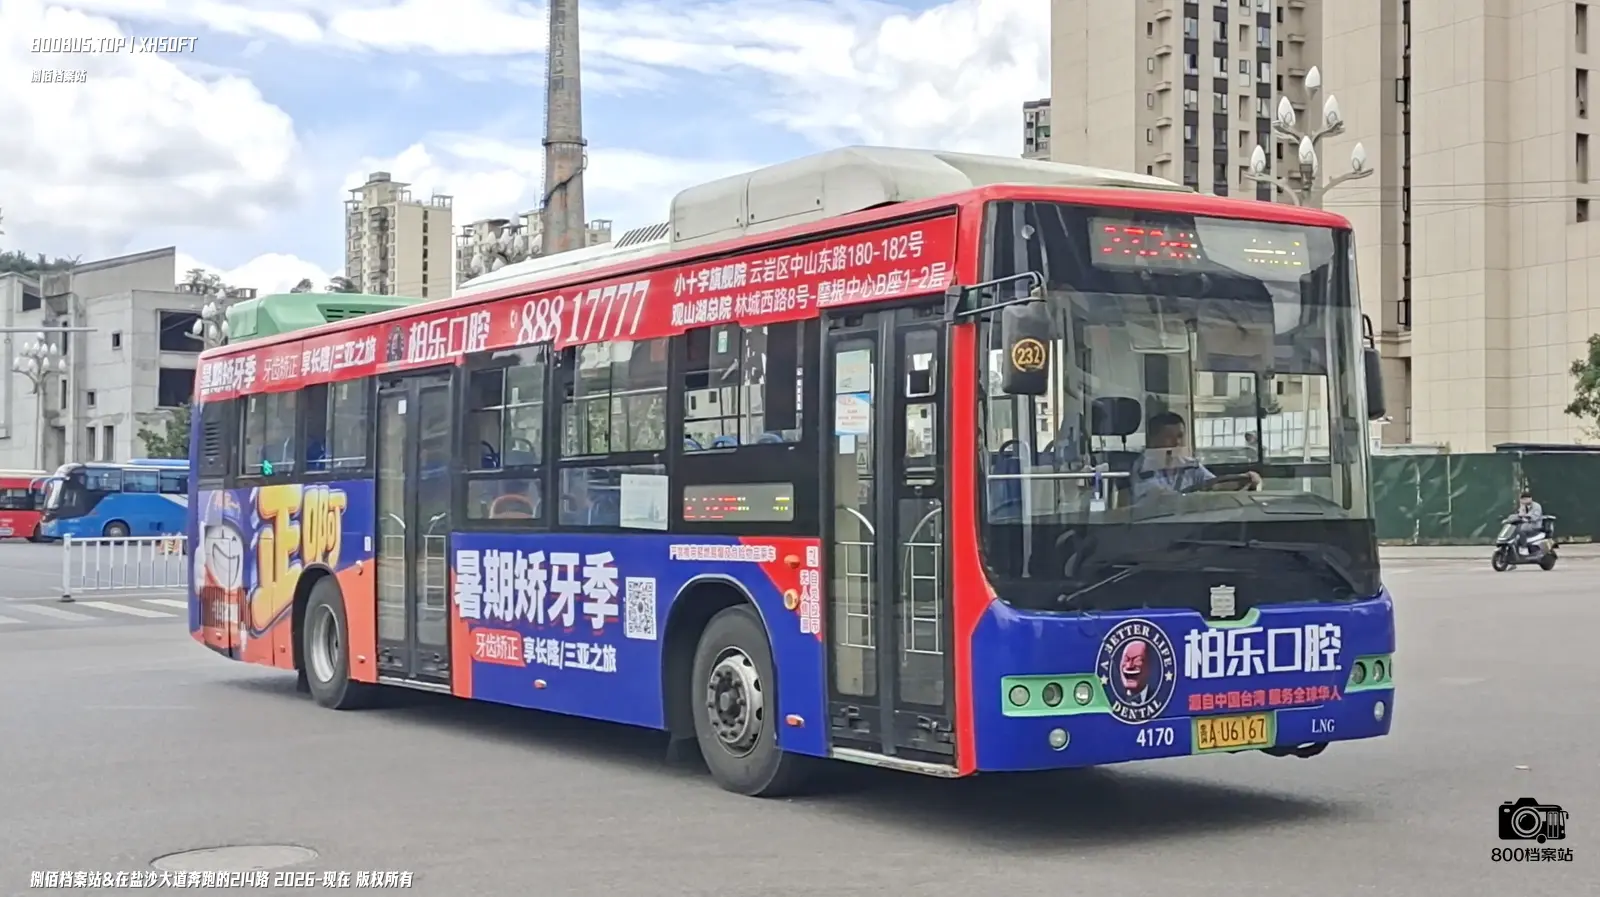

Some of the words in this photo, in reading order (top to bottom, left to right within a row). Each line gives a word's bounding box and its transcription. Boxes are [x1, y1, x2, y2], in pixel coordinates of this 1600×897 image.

[674, 261, 748, 298] 小十字旗舰院
[750, 230, 924, 282] 云岩区中山东路180-182号
[670, 300, 732, 327] 观山湖总院
[407, 310, 491, 364] 柏乐口腔
[1017, 346, 1041, 365] 232
[454, 549, 620, 630] 暑期矫牙季
[475, 632, 520, 661] 牙齿矫正
[1104, 624, 1150, 654] BETTER
[1152, 633, 1173, 668] LIFE
[1184, 622, 1343, 680] 柏乐口腔
[1112, 700, 1162, 720] DENTAL
[1136, 727, 1174, 747] 4170
[1311, 718, 1336, 733] LNG
